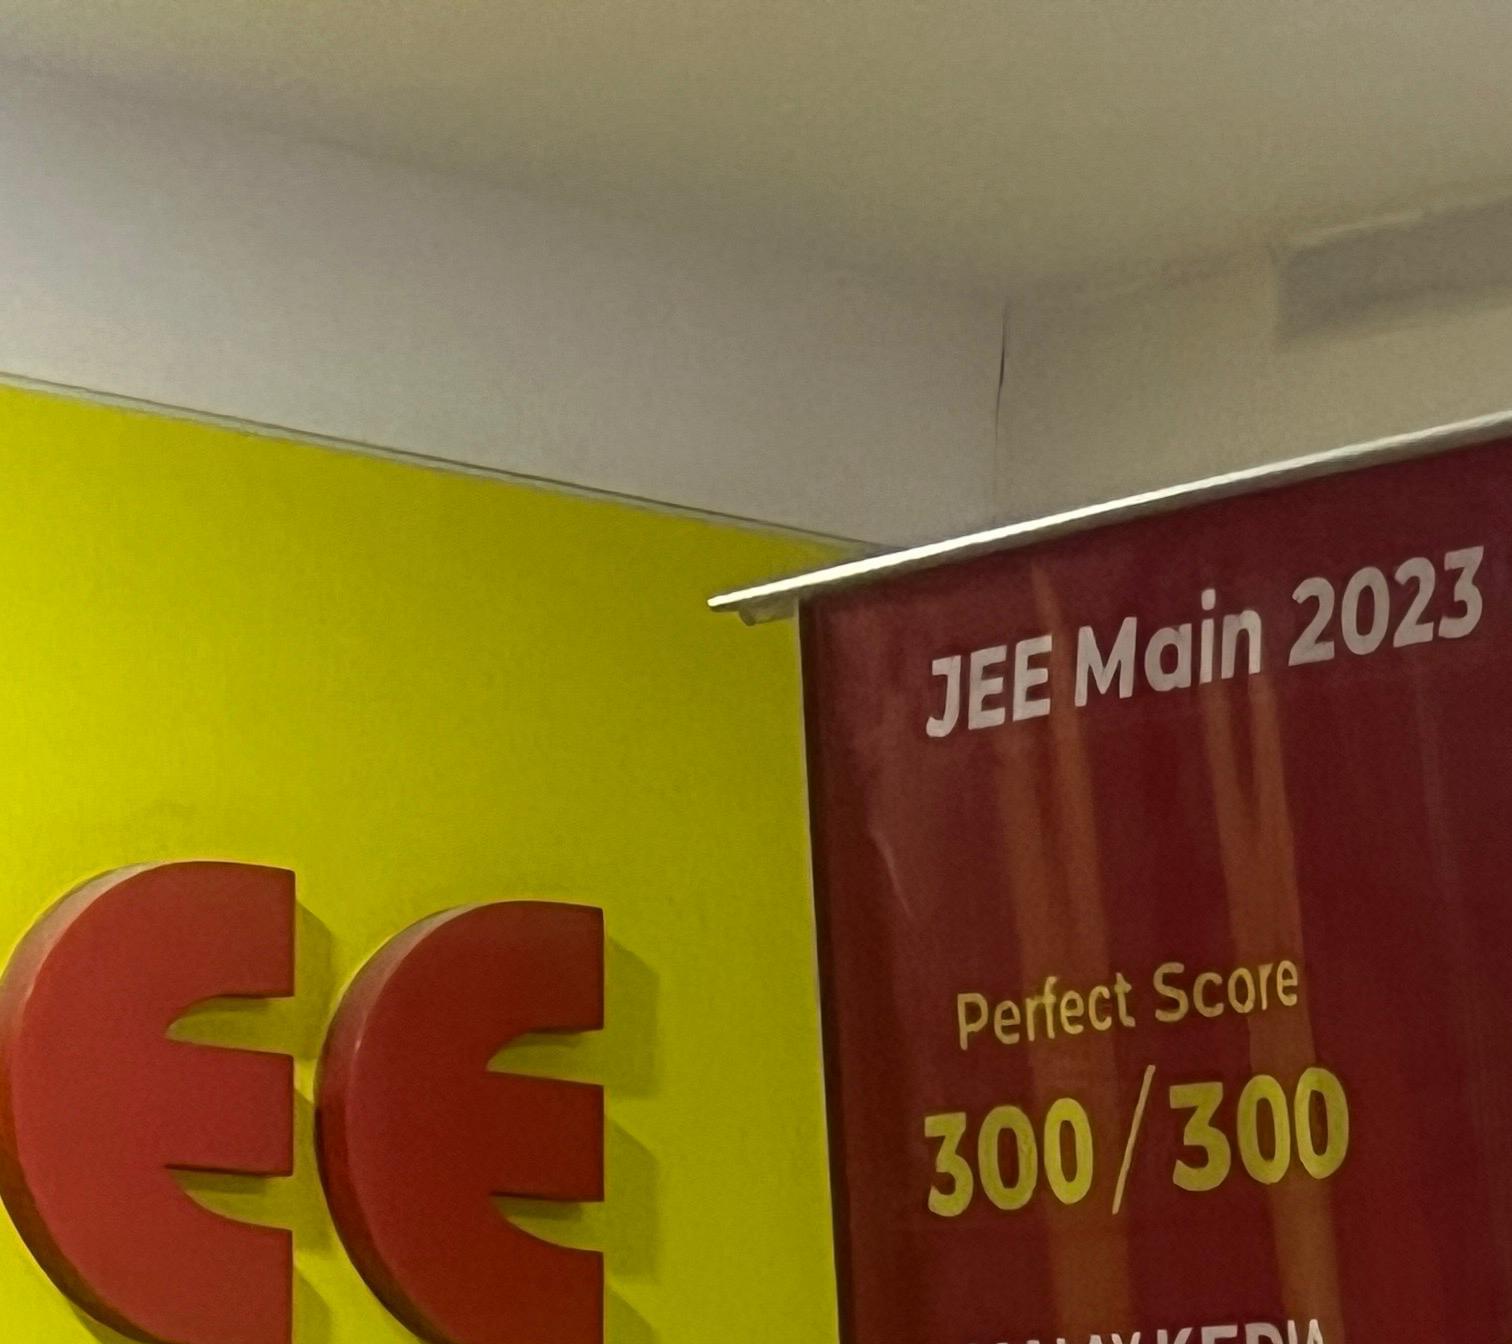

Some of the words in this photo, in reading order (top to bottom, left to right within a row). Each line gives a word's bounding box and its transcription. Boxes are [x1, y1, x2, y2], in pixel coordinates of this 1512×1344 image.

[925, 632, 1053, 739] JEE
[1073, 590, 1264, 709] Main
[1287, 545, 1484, 669] 2023
[955, 969, 1137, 1053] Perfect
[1153, 953, 1299, 1025] Score
